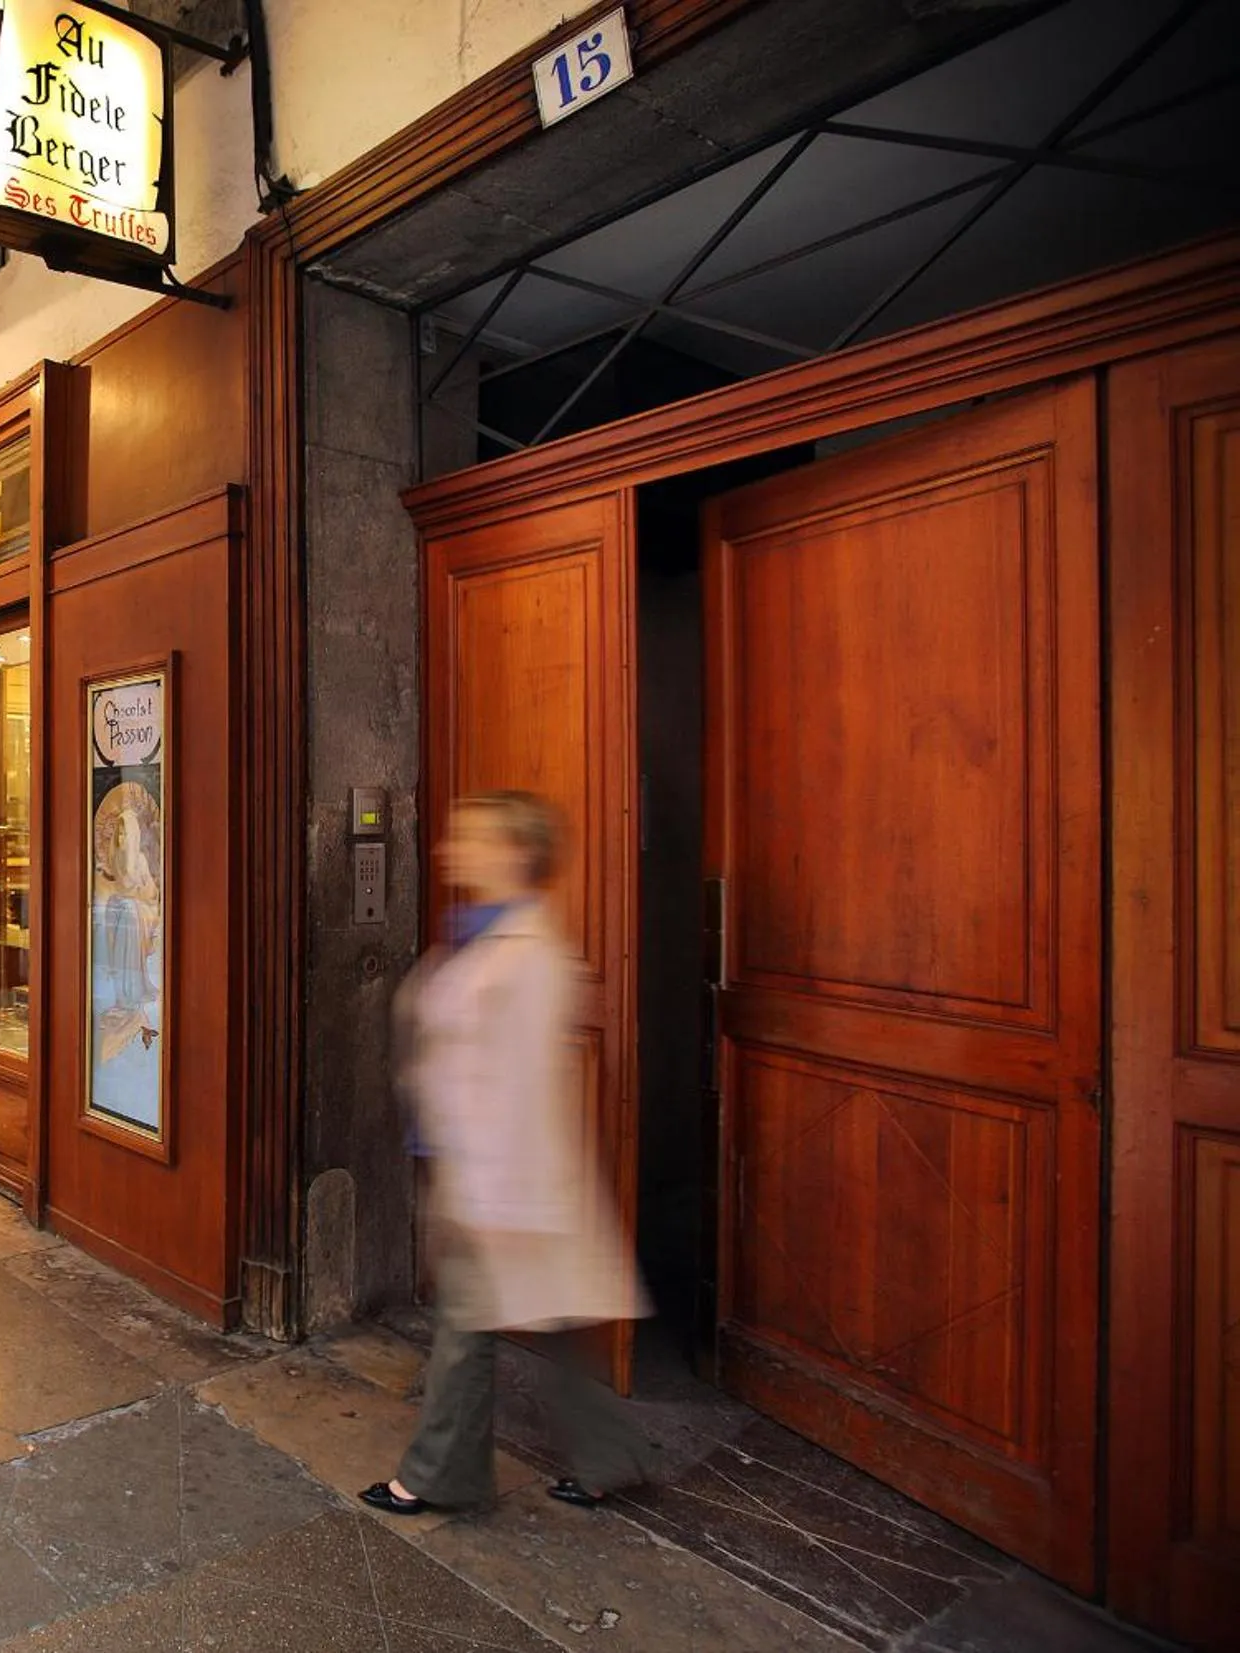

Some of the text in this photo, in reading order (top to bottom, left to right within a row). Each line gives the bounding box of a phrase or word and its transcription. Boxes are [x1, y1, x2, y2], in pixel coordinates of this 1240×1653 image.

[55, 13, 104, 68] Au
[551, 32, 611, 108] 15
[21, 62, 126, 131] Fidele
[5, 109, 126, 187] Berger
[4, 177, 57, 217] Ses
